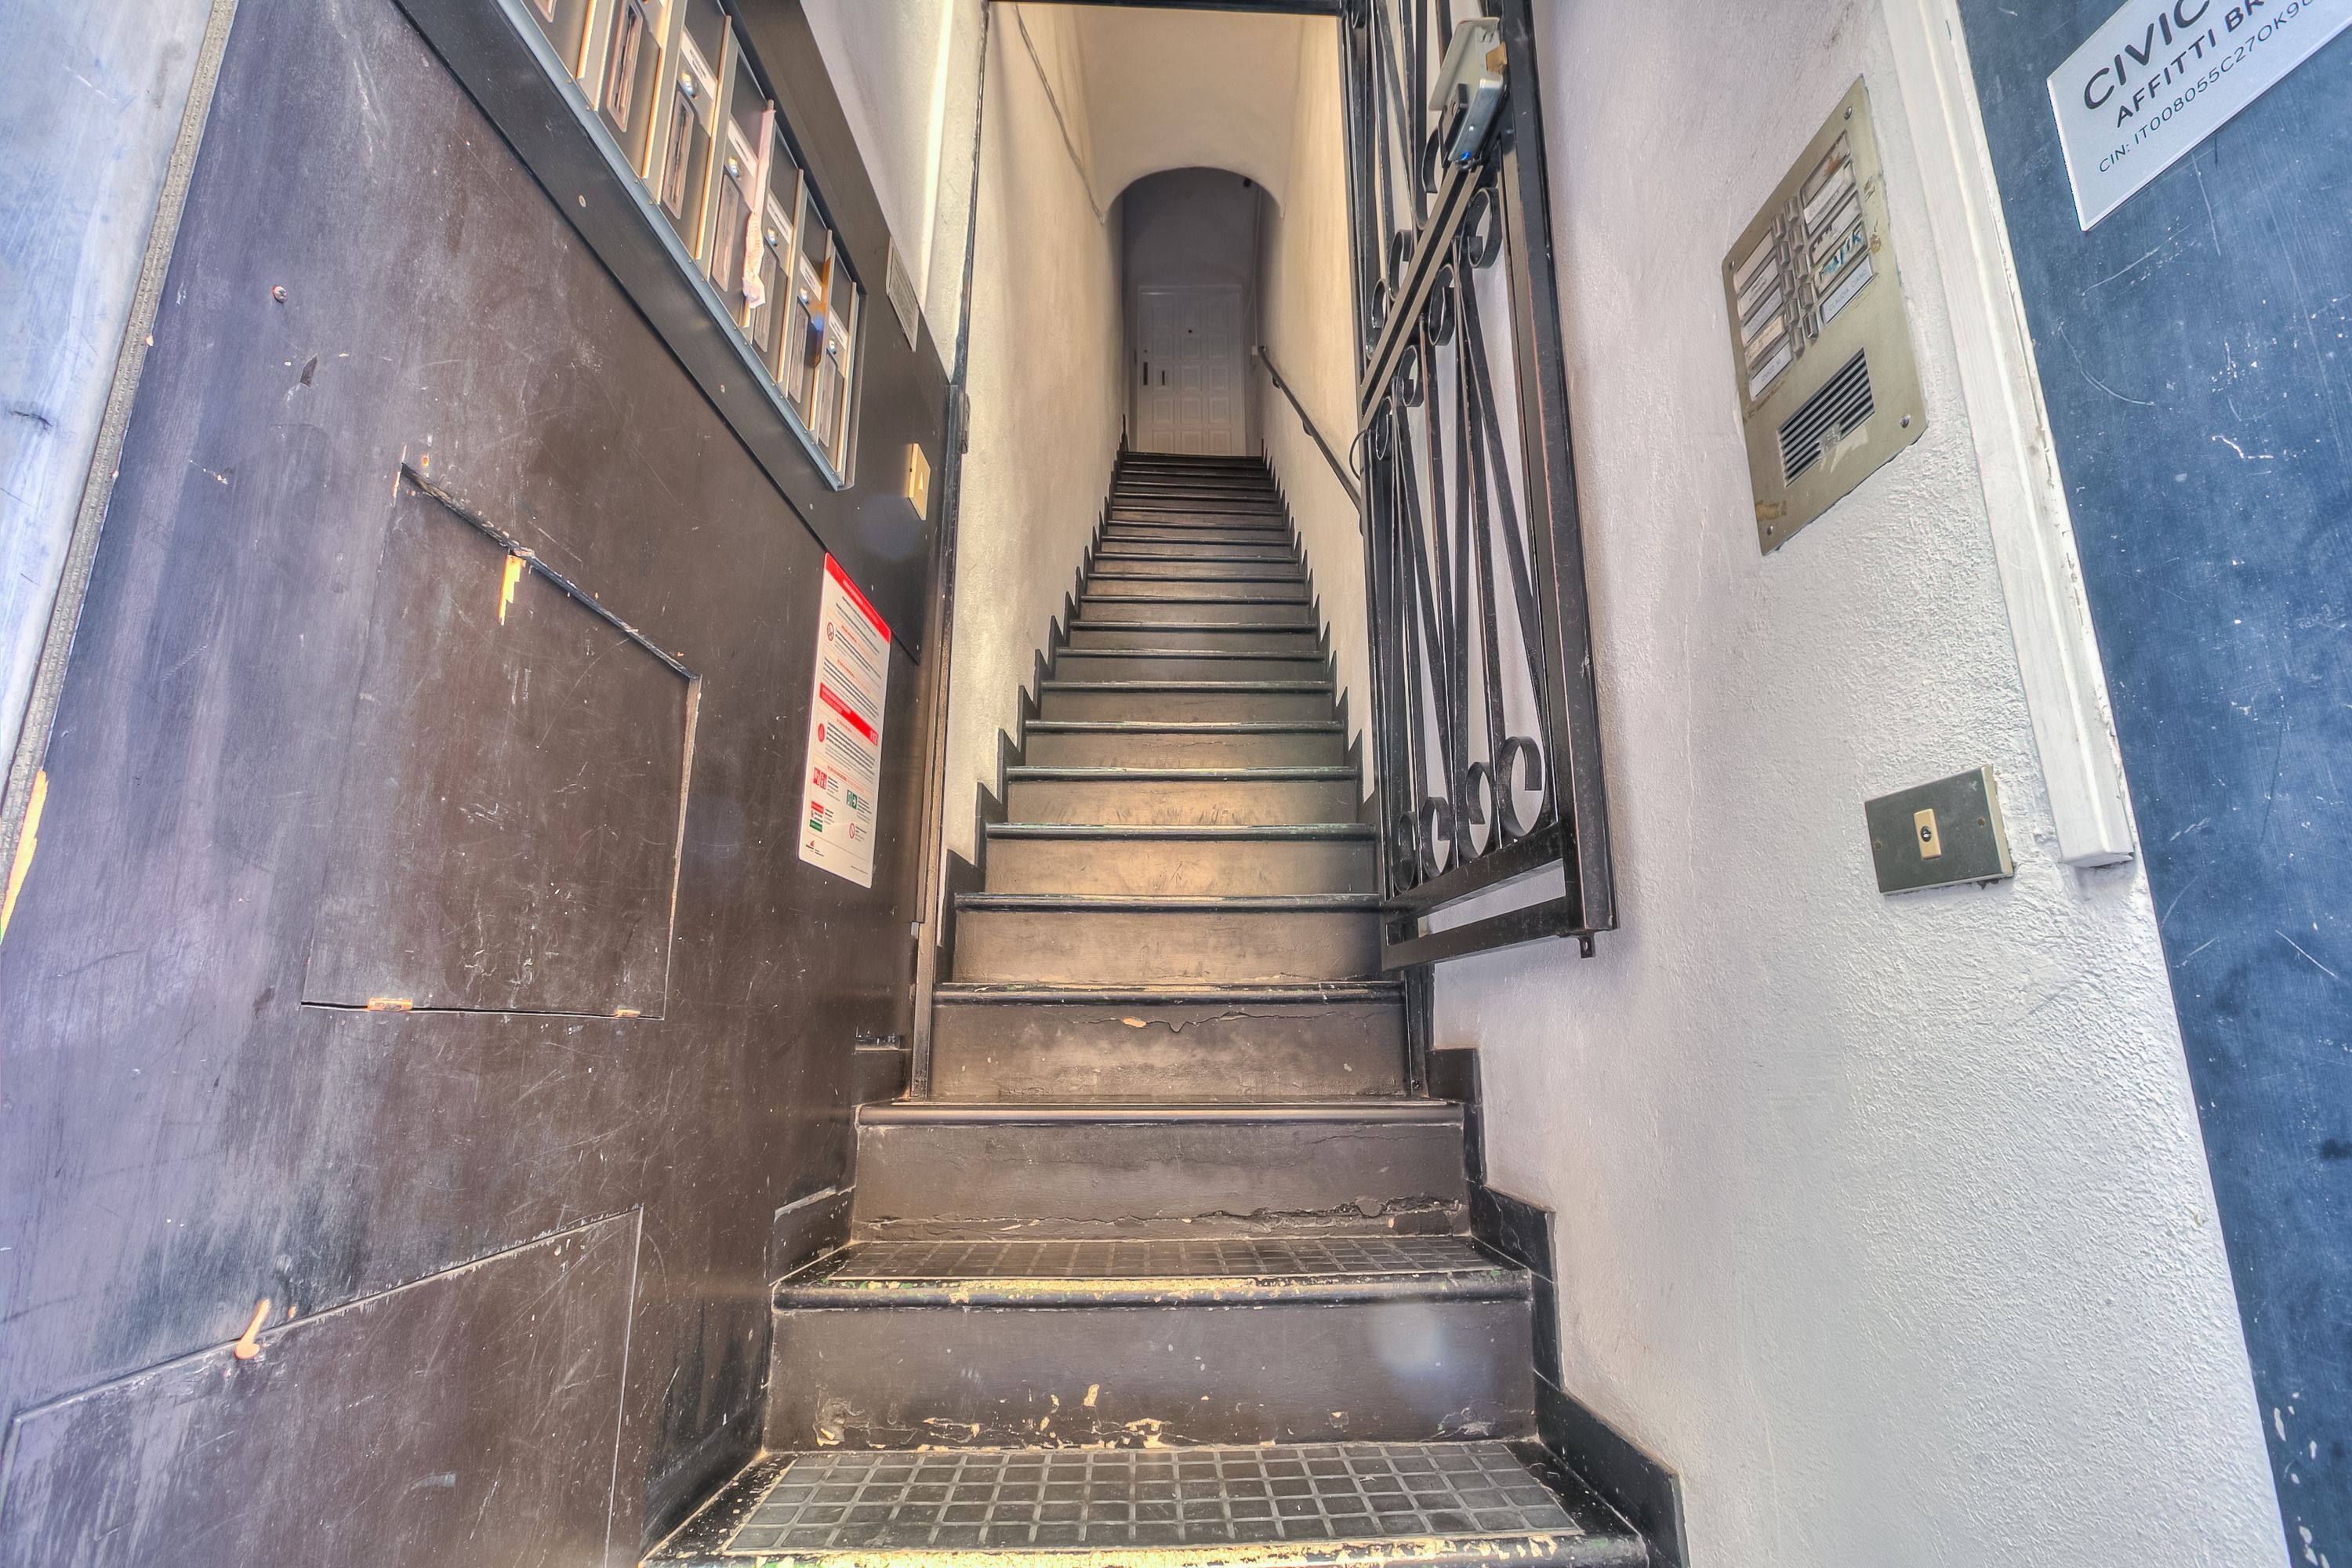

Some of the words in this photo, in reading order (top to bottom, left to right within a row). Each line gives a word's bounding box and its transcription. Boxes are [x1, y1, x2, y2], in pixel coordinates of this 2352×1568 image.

[2084, 0, 2209, 110] CIVIC
[2118, 29, 2216, 128] AFFITTI
[2099, 143, 2131, 172] CIN:
